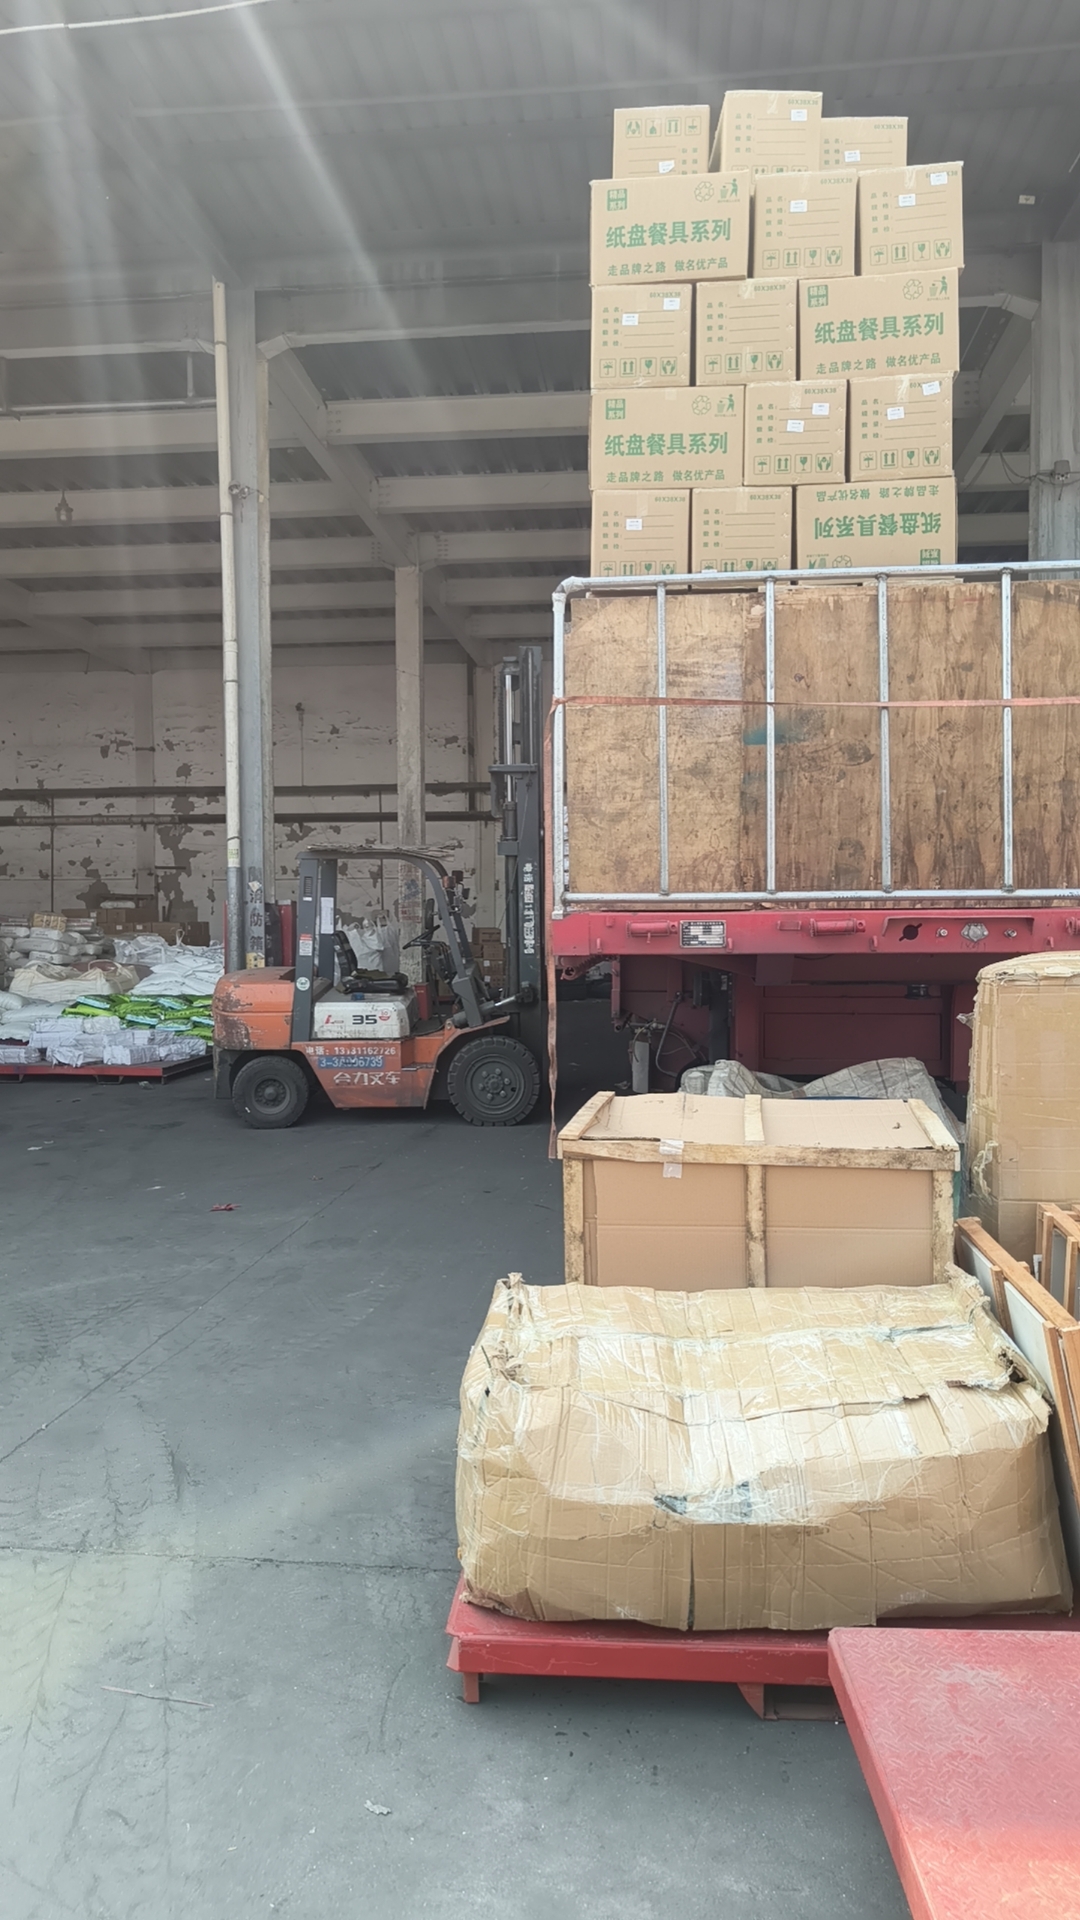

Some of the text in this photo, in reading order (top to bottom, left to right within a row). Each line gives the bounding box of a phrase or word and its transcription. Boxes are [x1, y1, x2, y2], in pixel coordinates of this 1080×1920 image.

[605, 217, 732, 249] 纸盘餐具系列
[607, 256, 729, 277] 走品牌之路 做名优产品
[814, 311, 945, 345] 纸盘餐具系列
[815, 352, 942, 375] 走品牌之路 做名优产品
[604, 431, 729, 457] 纸盘餐具系列
[606, 469, 726, 484] 走品牌之路 做名优产品
[813, 511, 942, 540] 纸盘餐具系列
[351, 1014, 378, 1025] 35
[333, 1071, 400, 1086] 合力叉车
